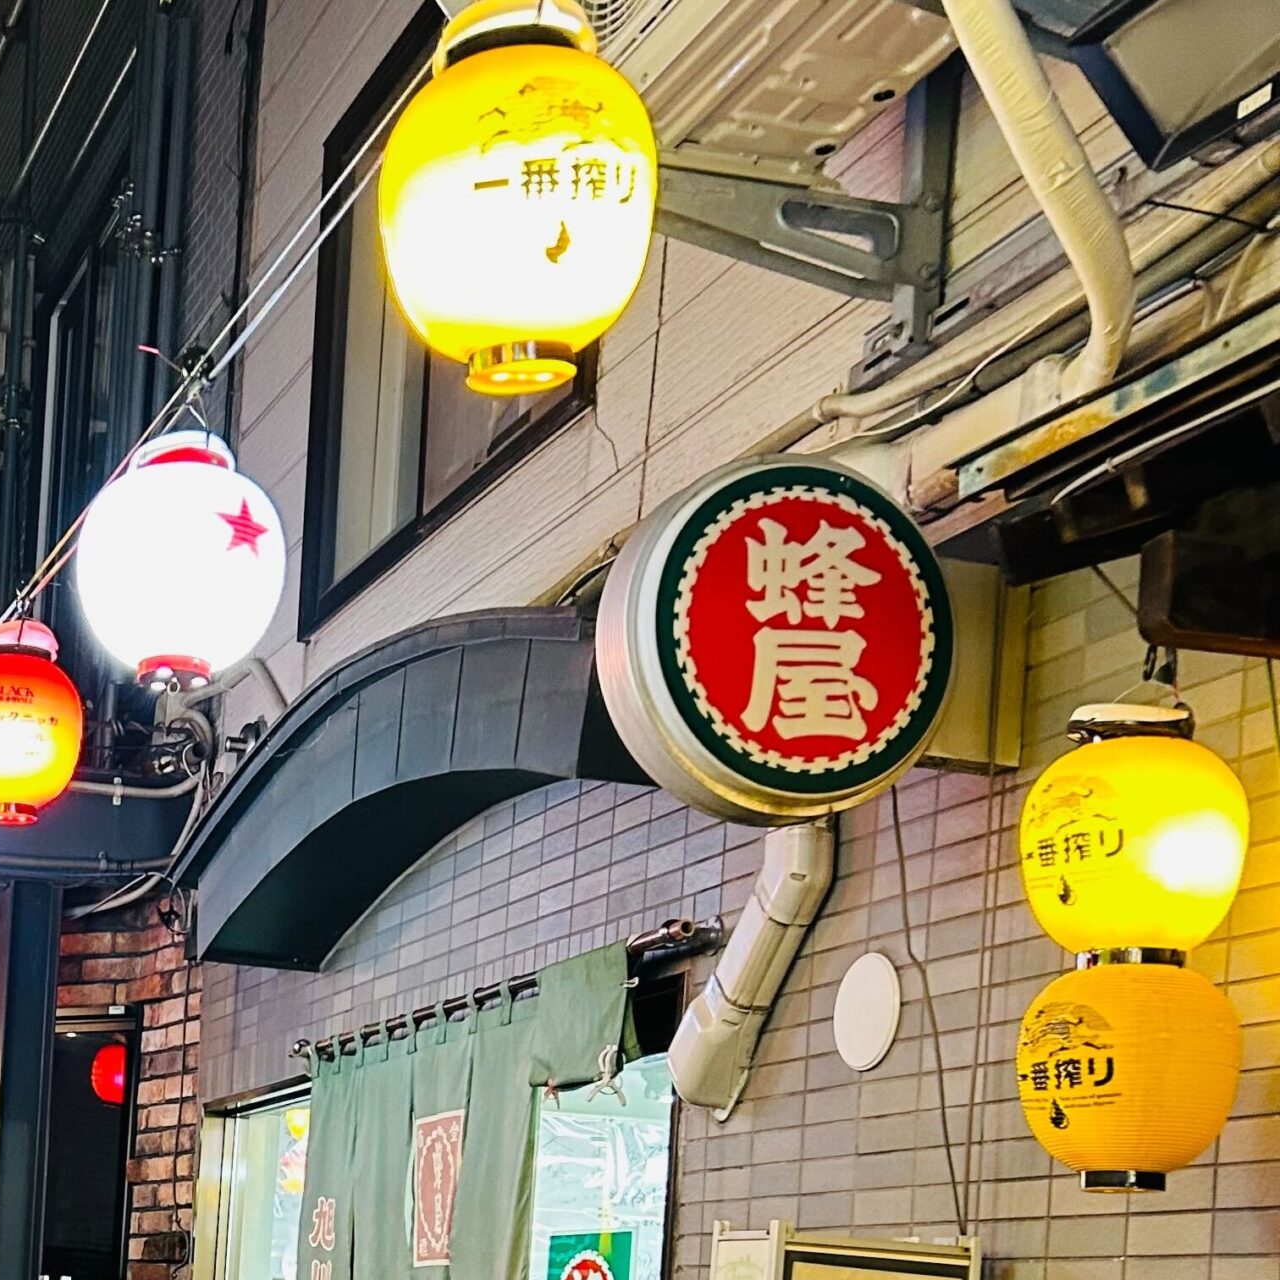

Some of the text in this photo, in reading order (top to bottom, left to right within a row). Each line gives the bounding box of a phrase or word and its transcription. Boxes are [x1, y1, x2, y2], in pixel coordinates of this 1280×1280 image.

[474, 157, 637, 204] 一番搾り
[738, 517, 882, 741] 蜂屋
[1025, 829, 1123, 868] 一番搾り
[1019, 1056, 1114, 1091] 一番搾り
